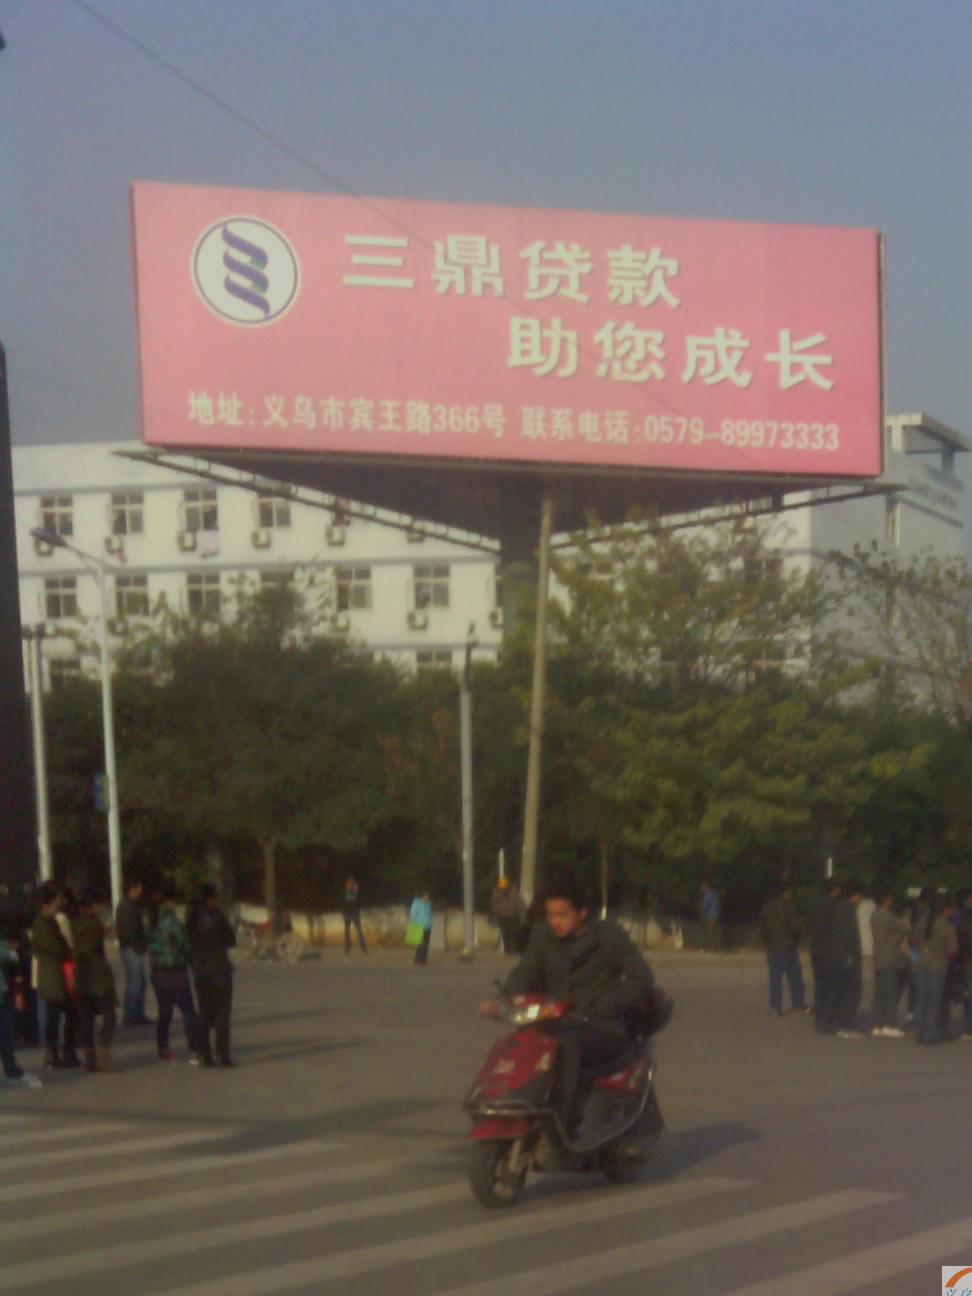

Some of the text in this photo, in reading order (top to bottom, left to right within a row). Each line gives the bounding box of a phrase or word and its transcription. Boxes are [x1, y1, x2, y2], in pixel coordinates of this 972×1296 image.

[342, 232, 681, 308] 三鼎贷款
[506, 316, 834, 390] 助您成长
